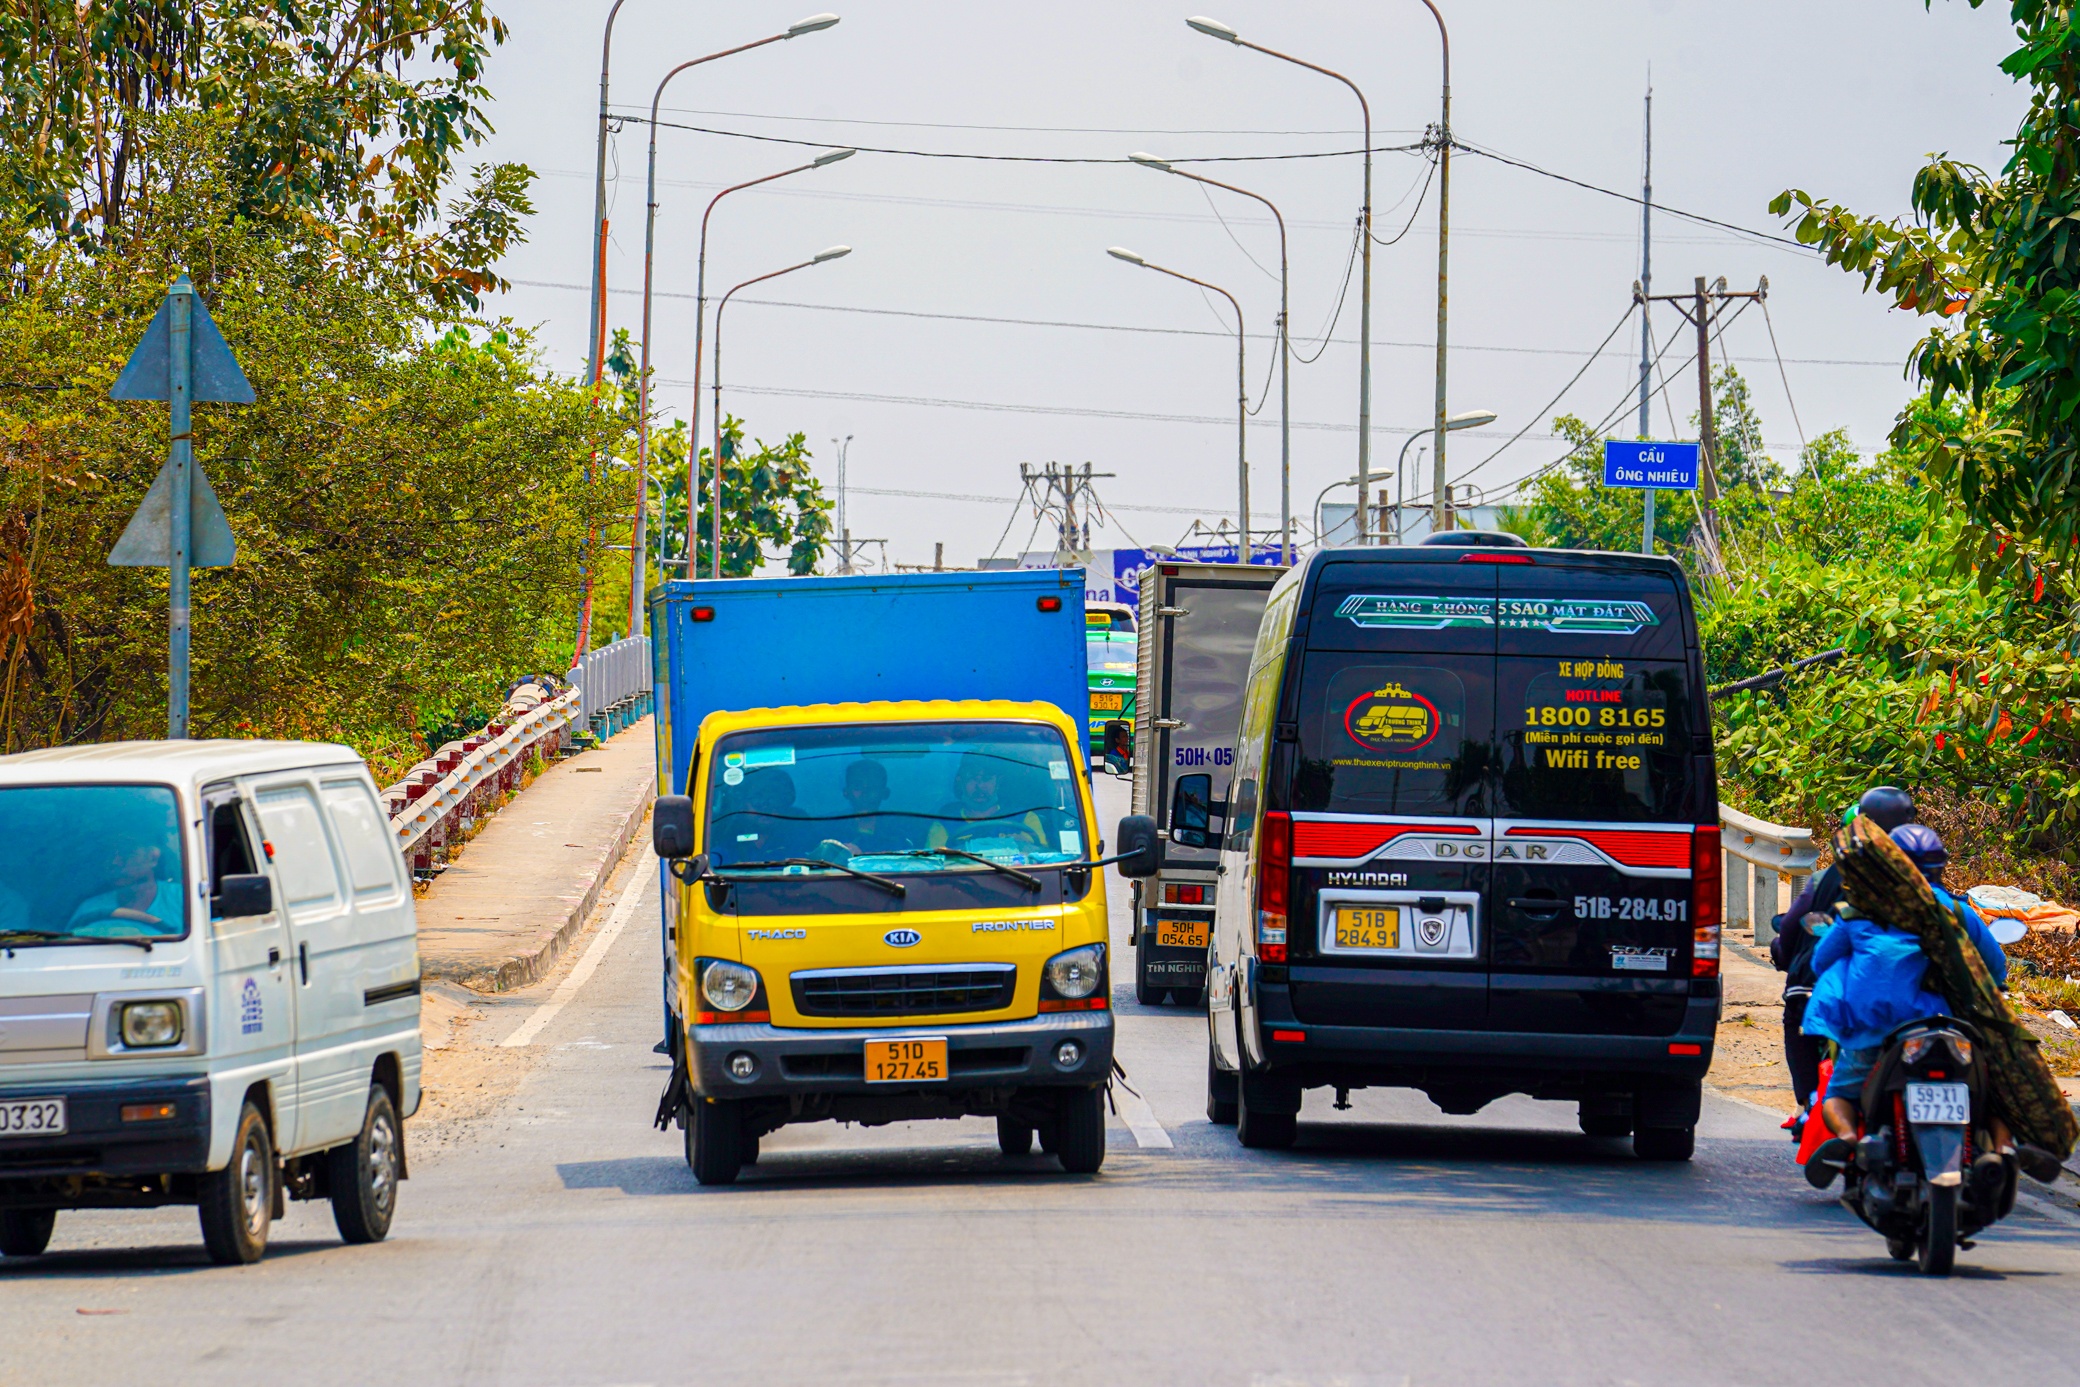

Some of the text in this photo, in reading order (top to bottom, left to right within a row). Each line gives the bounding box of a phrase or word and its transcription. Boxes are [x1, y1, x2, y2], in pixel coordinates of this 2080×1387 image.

[1638, 446, 1665, 463] CẦU
[1616, 466, 1689, 483] ÔNG NHIÊU
[1375, 600, 1626, 618] HÀNG KHÔNG 5 SAO MẶT ĐẤT
[1559, 655, 1624, 681] XE HỢP ĐỒNG
[1565, 690, 1622, 702] HOTLINE
[1525, 707, 1665, 727] 1800 8165
[1525, 730, 1664, 746] (Miễn phí cuộc gọi đến)
[1175, 747, 1204, 765] 50H
[1331, 758, 1451, 771] www.thuexeviptruongthinh.vn
[1546, 749, 1641, 769] Wifi free
[1435, 841, 1548, 860] DCAR
[1328, 872, 1407, 886] HYUNDAI
[1574, 896, 1687, 922] 51B-284.91
[972, 919, 1055, 933] FRONTIER
[1172, 922, 1194, 933] 50H
[1351, 911, 1385, 928] 51B
[747, 928, 807, 940] THACO
[889, 931, 917, 946] KIA
[1162, 934, 1203, 946] 054.65
[1338, 929, 1397, 948] 284.91
[888, 1042, 924, 1060] 51D
[876, 1062, 938, 1080] 127.45
[1917, 1087, 1957, 1103] 59-X1
[1912, 1104, 1965, 1121] 577.29
